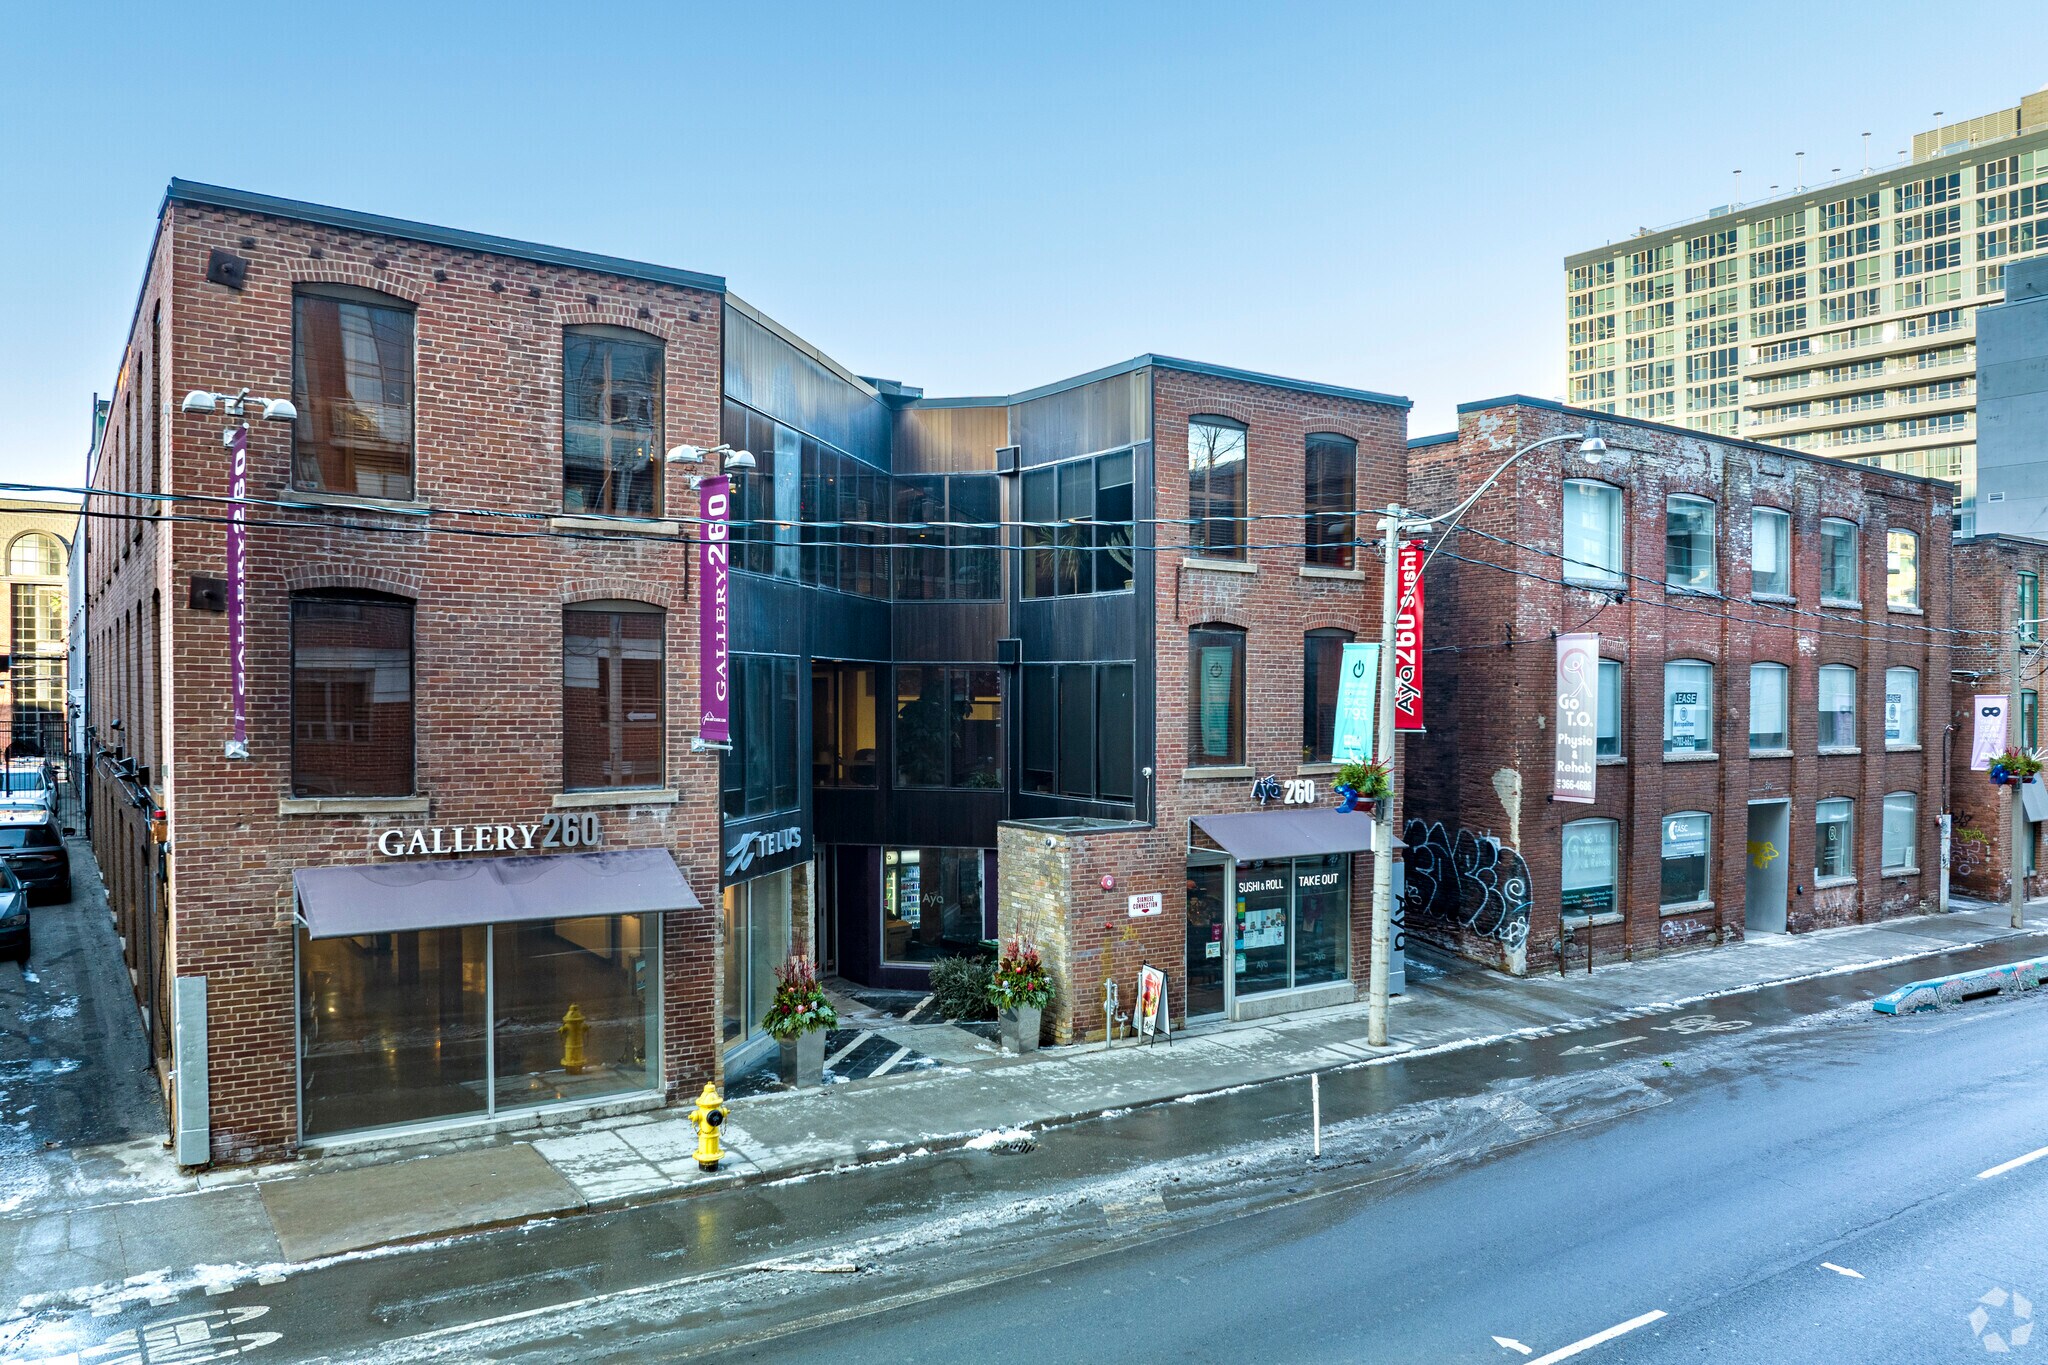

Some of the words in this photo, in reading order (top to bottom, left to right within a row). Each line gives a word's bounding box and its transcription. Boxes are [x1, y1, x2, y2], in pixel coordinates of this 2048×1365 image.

[708, 493, 728, 566] 260
[715, 566, 727, 702] GALLERY
[1396, 614, 1416, 665] 260
[1396, 665, 1421, 716] Aya
[1675, 693, 1696, 703] LEASE
[1558, 693, 1580, 710] Go
[1566, 711, 1594, 727] T.O.
[1558, 733, 1593, 749] Physio
[1571, 750, 1578, 760] &
[1557, 760, 1592, 774] Rehab
[1250, 779, 1281, 805] Aya
[1283, 780, 1315, 805] 260
[378, 824, 541, 857] GALLERY
[542, 812, 600, 848] 260
[756, 827, 802, 858] TELUS
[1238, 881, 1260, 893] SUSHI
[1260, 883, 1265, 891] &
[1265, 879, 1284, 890] ROLL
[1299, 875, 1321, 887] TAKE
[1321, 873, 1339, 885] OUT
[922, 893, 944, 907] Aya
[1132, 901, 1158, 910] CONNECTION
